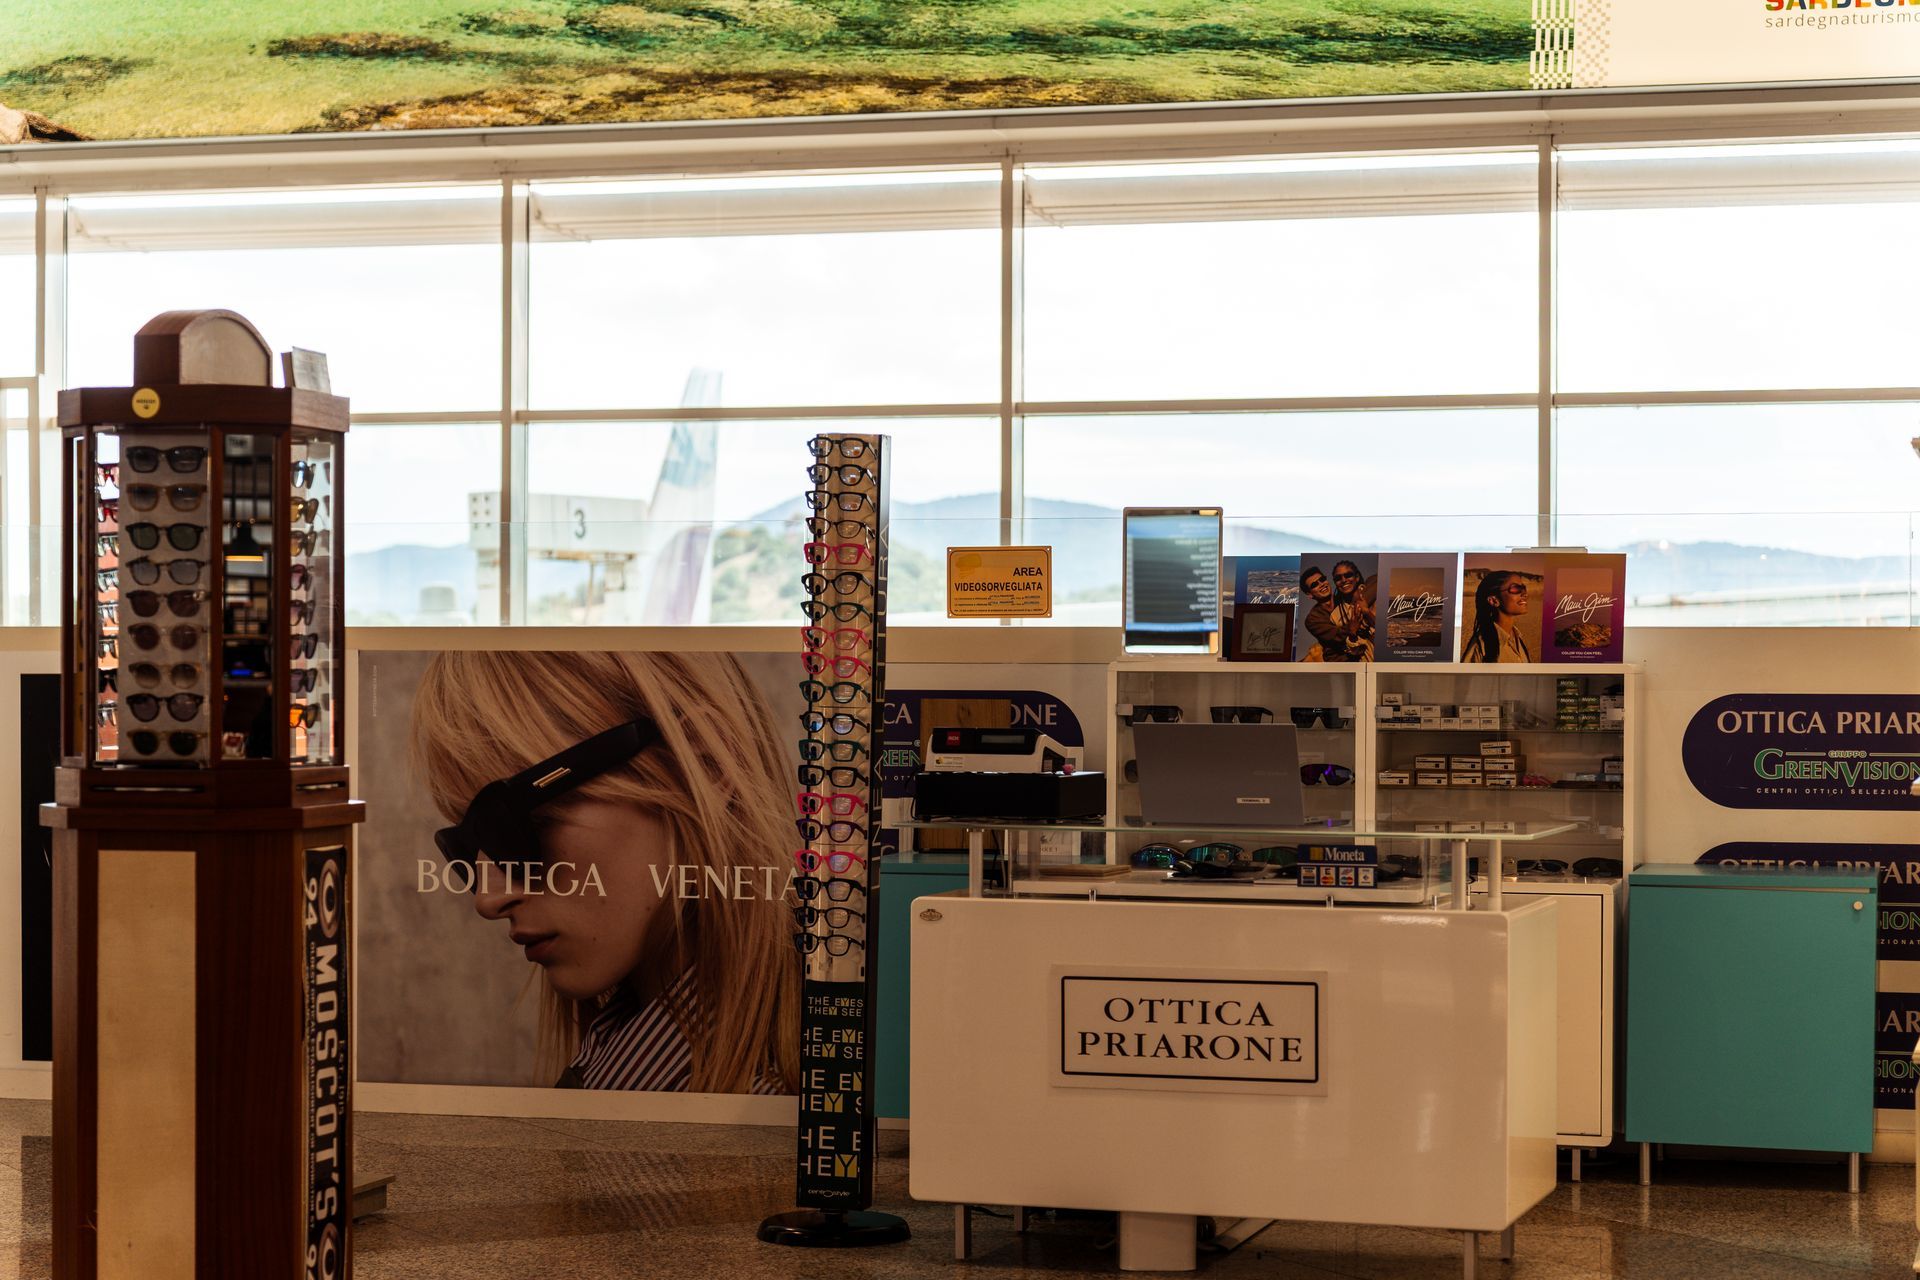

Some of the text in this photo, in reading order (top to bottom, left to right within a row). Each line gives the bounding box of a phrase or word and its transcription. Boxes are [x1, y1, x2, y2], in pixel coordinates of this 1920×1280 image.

[574, 509, 587, 539] 3
[1013, 567, 1043, 577] AREA
[954, 582, 1043, 592] VIDEOSORVEGLIATA
[1388, 592, 1449, 623] Maui Jim
[1554, 592, 1618, 623] Maui Jim
[1716, 710, 1920, 735] OTTICA PRIAR
[1828, 750, 1867, 758] GRUPPO
[1325, 847, 1365, 861] Moneta
[416, 858, 805, 902] BOTTEGA VENETA
[304, 877, 318, 930] 94
[808, 996, 864, 1008] THE EYES
[808, 1006, 862, 1017] THEY SEE
[1104, 997, 1274, 1027] OTTICA
[843, 1046, 863, 1061] SE
[1077, 1031, 1303, 1063] PRIARONE
[315, 944, 339, 1222] MOSCOT'S
